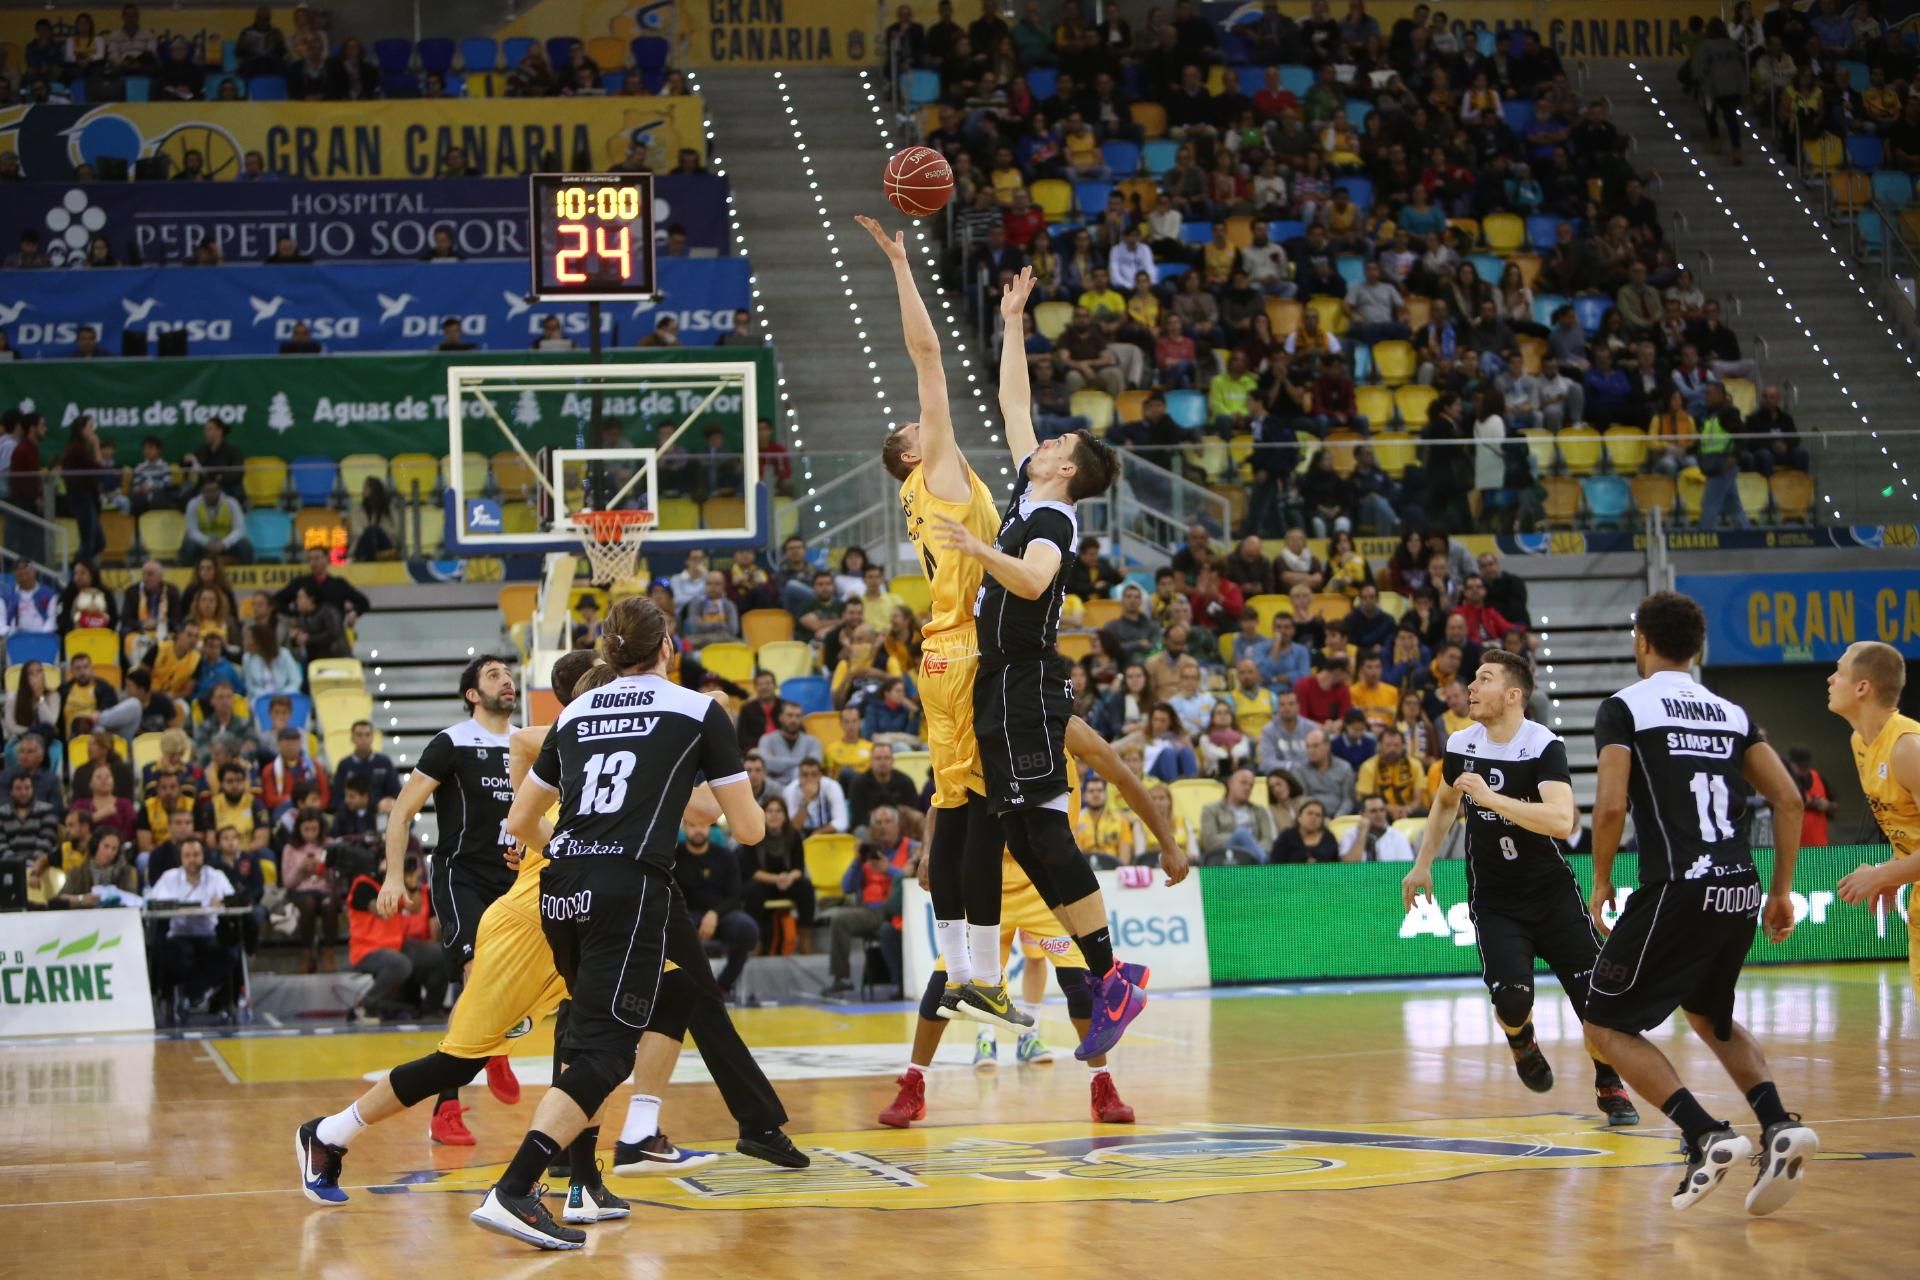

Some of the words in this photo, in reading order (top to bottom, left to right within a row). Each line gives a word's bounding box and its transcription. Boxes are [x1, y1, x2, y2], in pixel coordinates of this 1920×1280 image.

[711, 0, 783, 24] GRAN
[711, 27, 832, 61] CANARIA
[1548, 18, 1684, 56] CANARIA
[266, 124, 382, 177] GRAN
[405, 123, 593, 176] CANARIA
[291, 193, 431, 215] HOSPITAL
[556, 187, 639, 220] 10:00
[136, 220, 356, 259] PERPETUO
[371, 218, 530, 256] SOCOR
[556, 224, 630, 282] 24
[147, 319, 232, 342] DSA
[275, 317, 360, 340] DSA
[142, 400, 178, 425] de
[180, 398, 247, 424] Teror
[312, 396, 391, 428] Aguas
[394, 394, 430, 421] de
[639, 390, 675, 414] de
[1668, 531, 1720, 549] CANARIA
[1748, 590, 1856, 648] GRAN
[591, 690, 656, 709] BOGRIS
[1661, 697, 1727, 722] HANNAH
[481, 776, 512, 789] DOMI
[576, 750, 637, 816] 13
[1689, 771, 1736, 843] 11
[564, 839, 625, 856] Bizkaia
[1499, 835, 1519, 861] 9
[1110, 909, 1190, 947] desa
[2, 963, 114, 1004] CARNE
